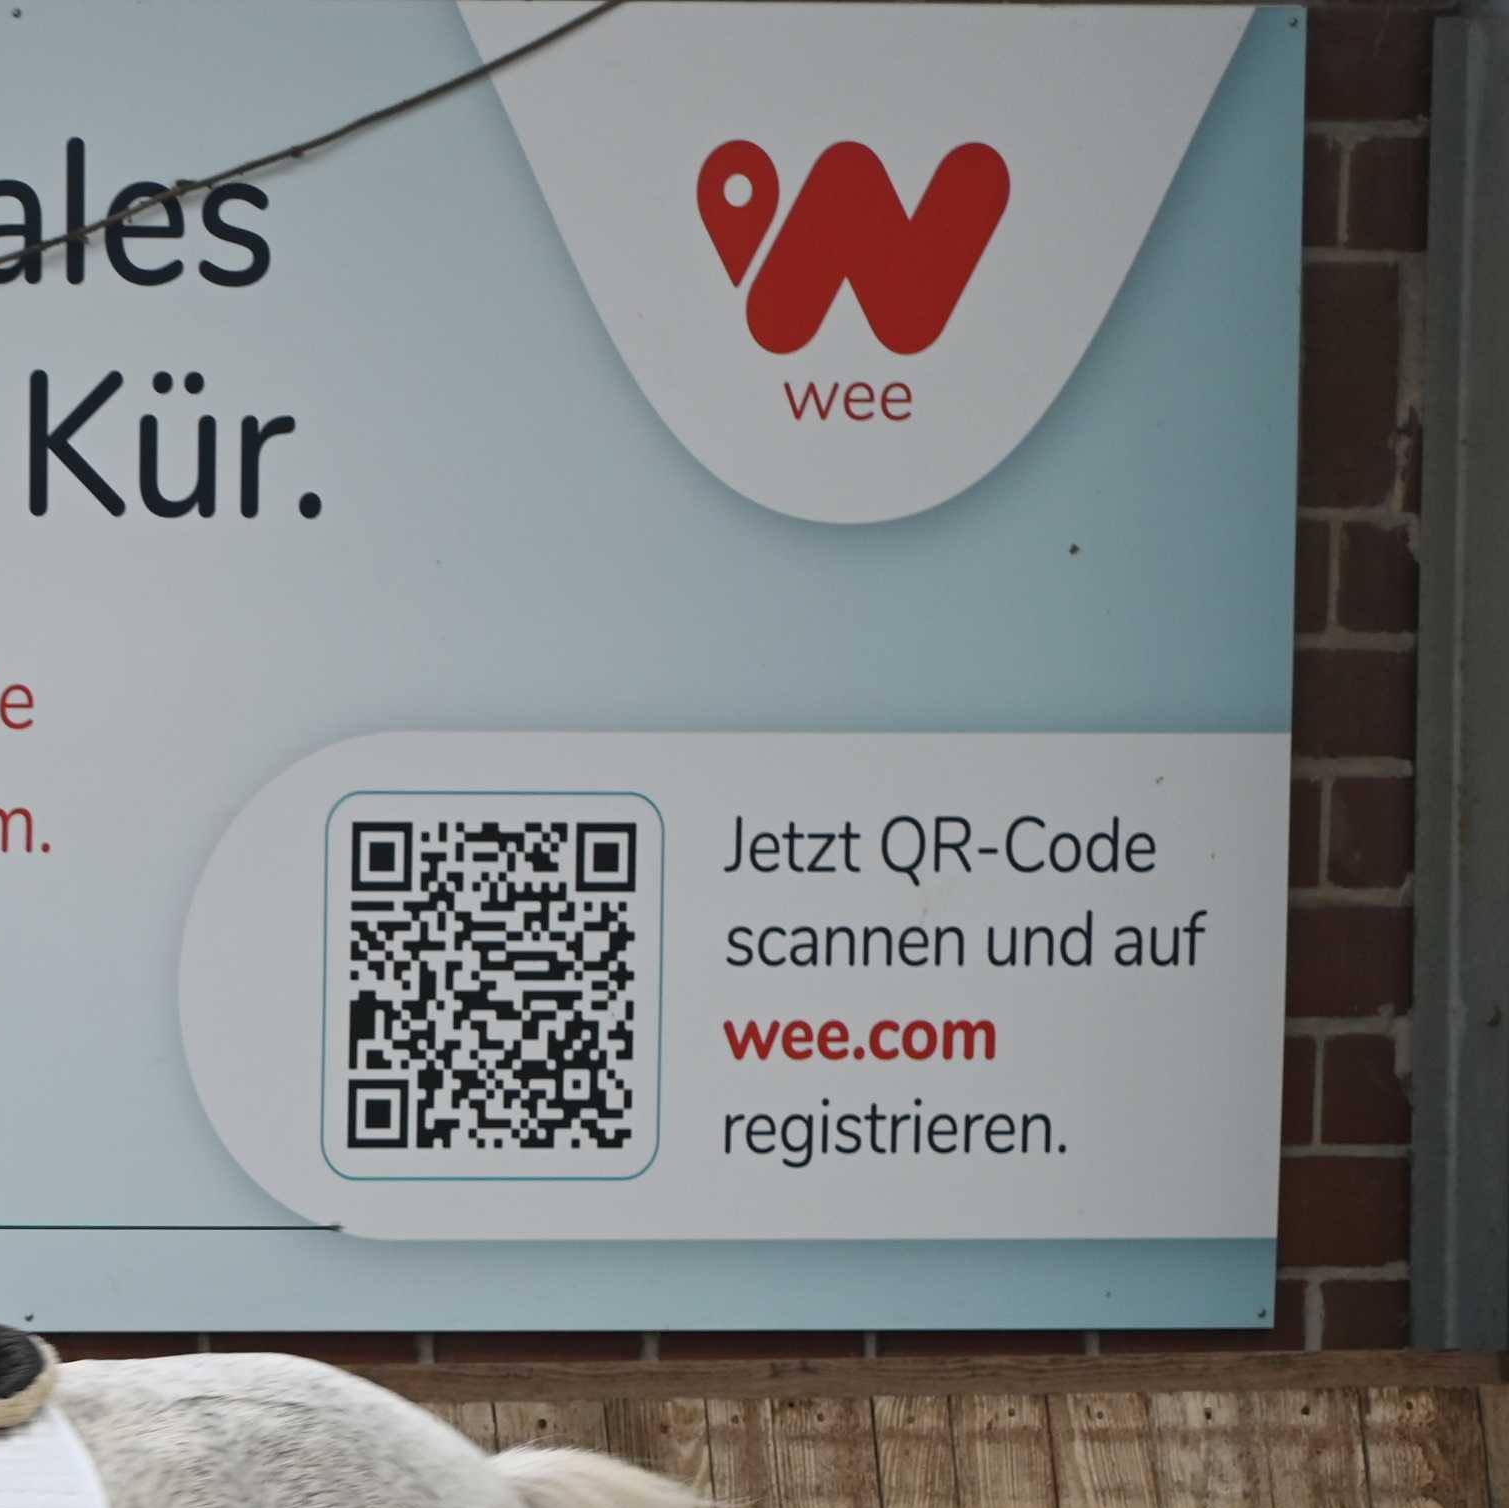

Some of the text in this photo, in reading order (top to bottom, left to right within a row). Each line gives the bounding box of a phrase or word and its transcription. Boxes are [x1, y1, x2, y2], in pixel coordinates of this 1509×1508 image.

[783, 381, 914, 423] wee
[29, 369, 323, 520] Kür.
[723, 815, 1157, 887] Jetzt QR-Code
[725, 909, 1208, 968] scannen und auf
[723, 1018, 997, 1061] wee.com
[723, 1097, 1068, 1169] registrieren.
